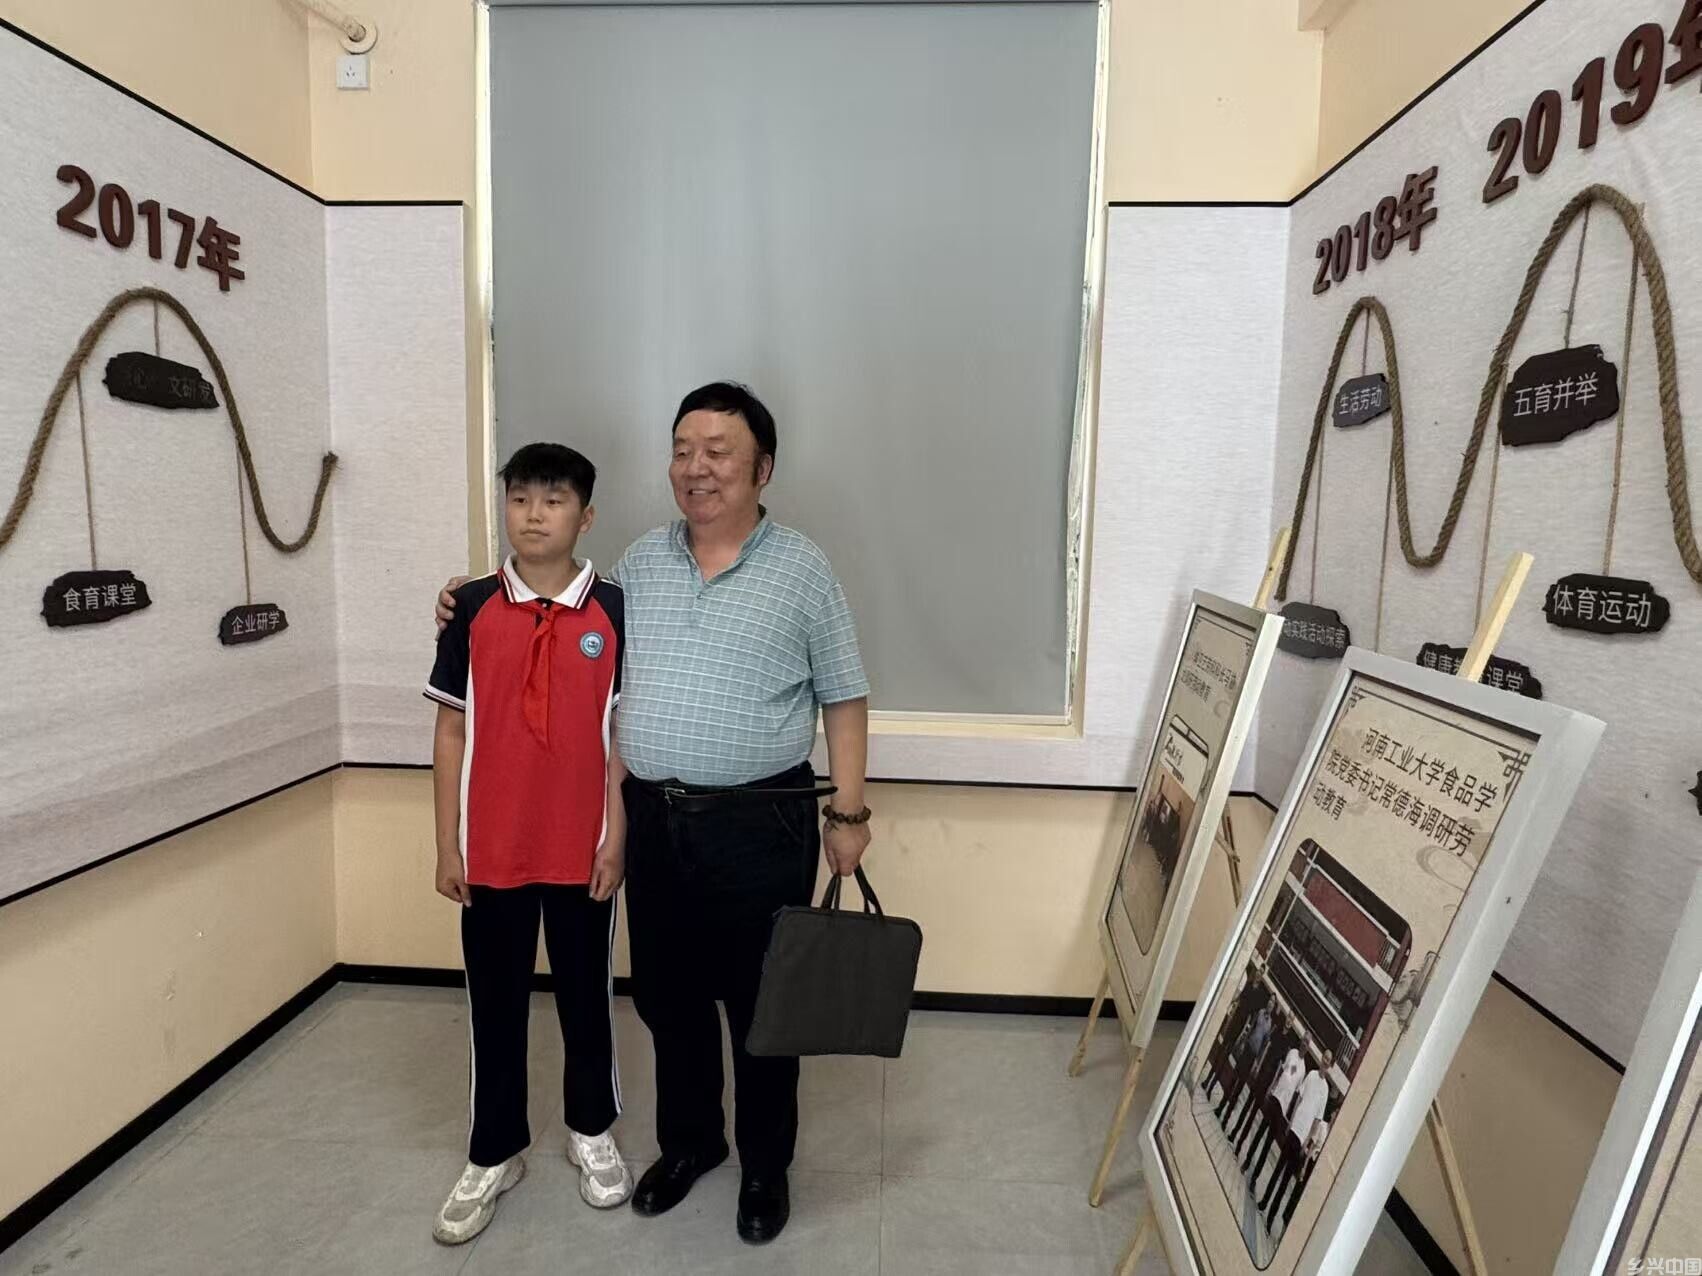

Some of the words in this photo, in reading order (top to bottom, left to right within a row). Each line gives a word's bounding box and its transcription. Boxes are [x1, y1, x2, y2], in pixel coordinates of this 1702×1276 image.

[56, 165, 245, 291] 2017年
[1313, 166, 1438, 294] 2018年
[1339, 385, 1382, 415] 生活劳动
[1514, 372, 1599, 417] 五育并举
[63, 583, 137, 612] 食育课堂
[1553, 585, 1652, 628] 体育运动
[232, 610, 280, 635] 企业研学
[1423, 650, 1524, 692] 健康课堂
[1361, 727, 1498, 813] 河南工业大学食品学
[1326, 750, 1475, 857] 院党委书记常德海调研劳
